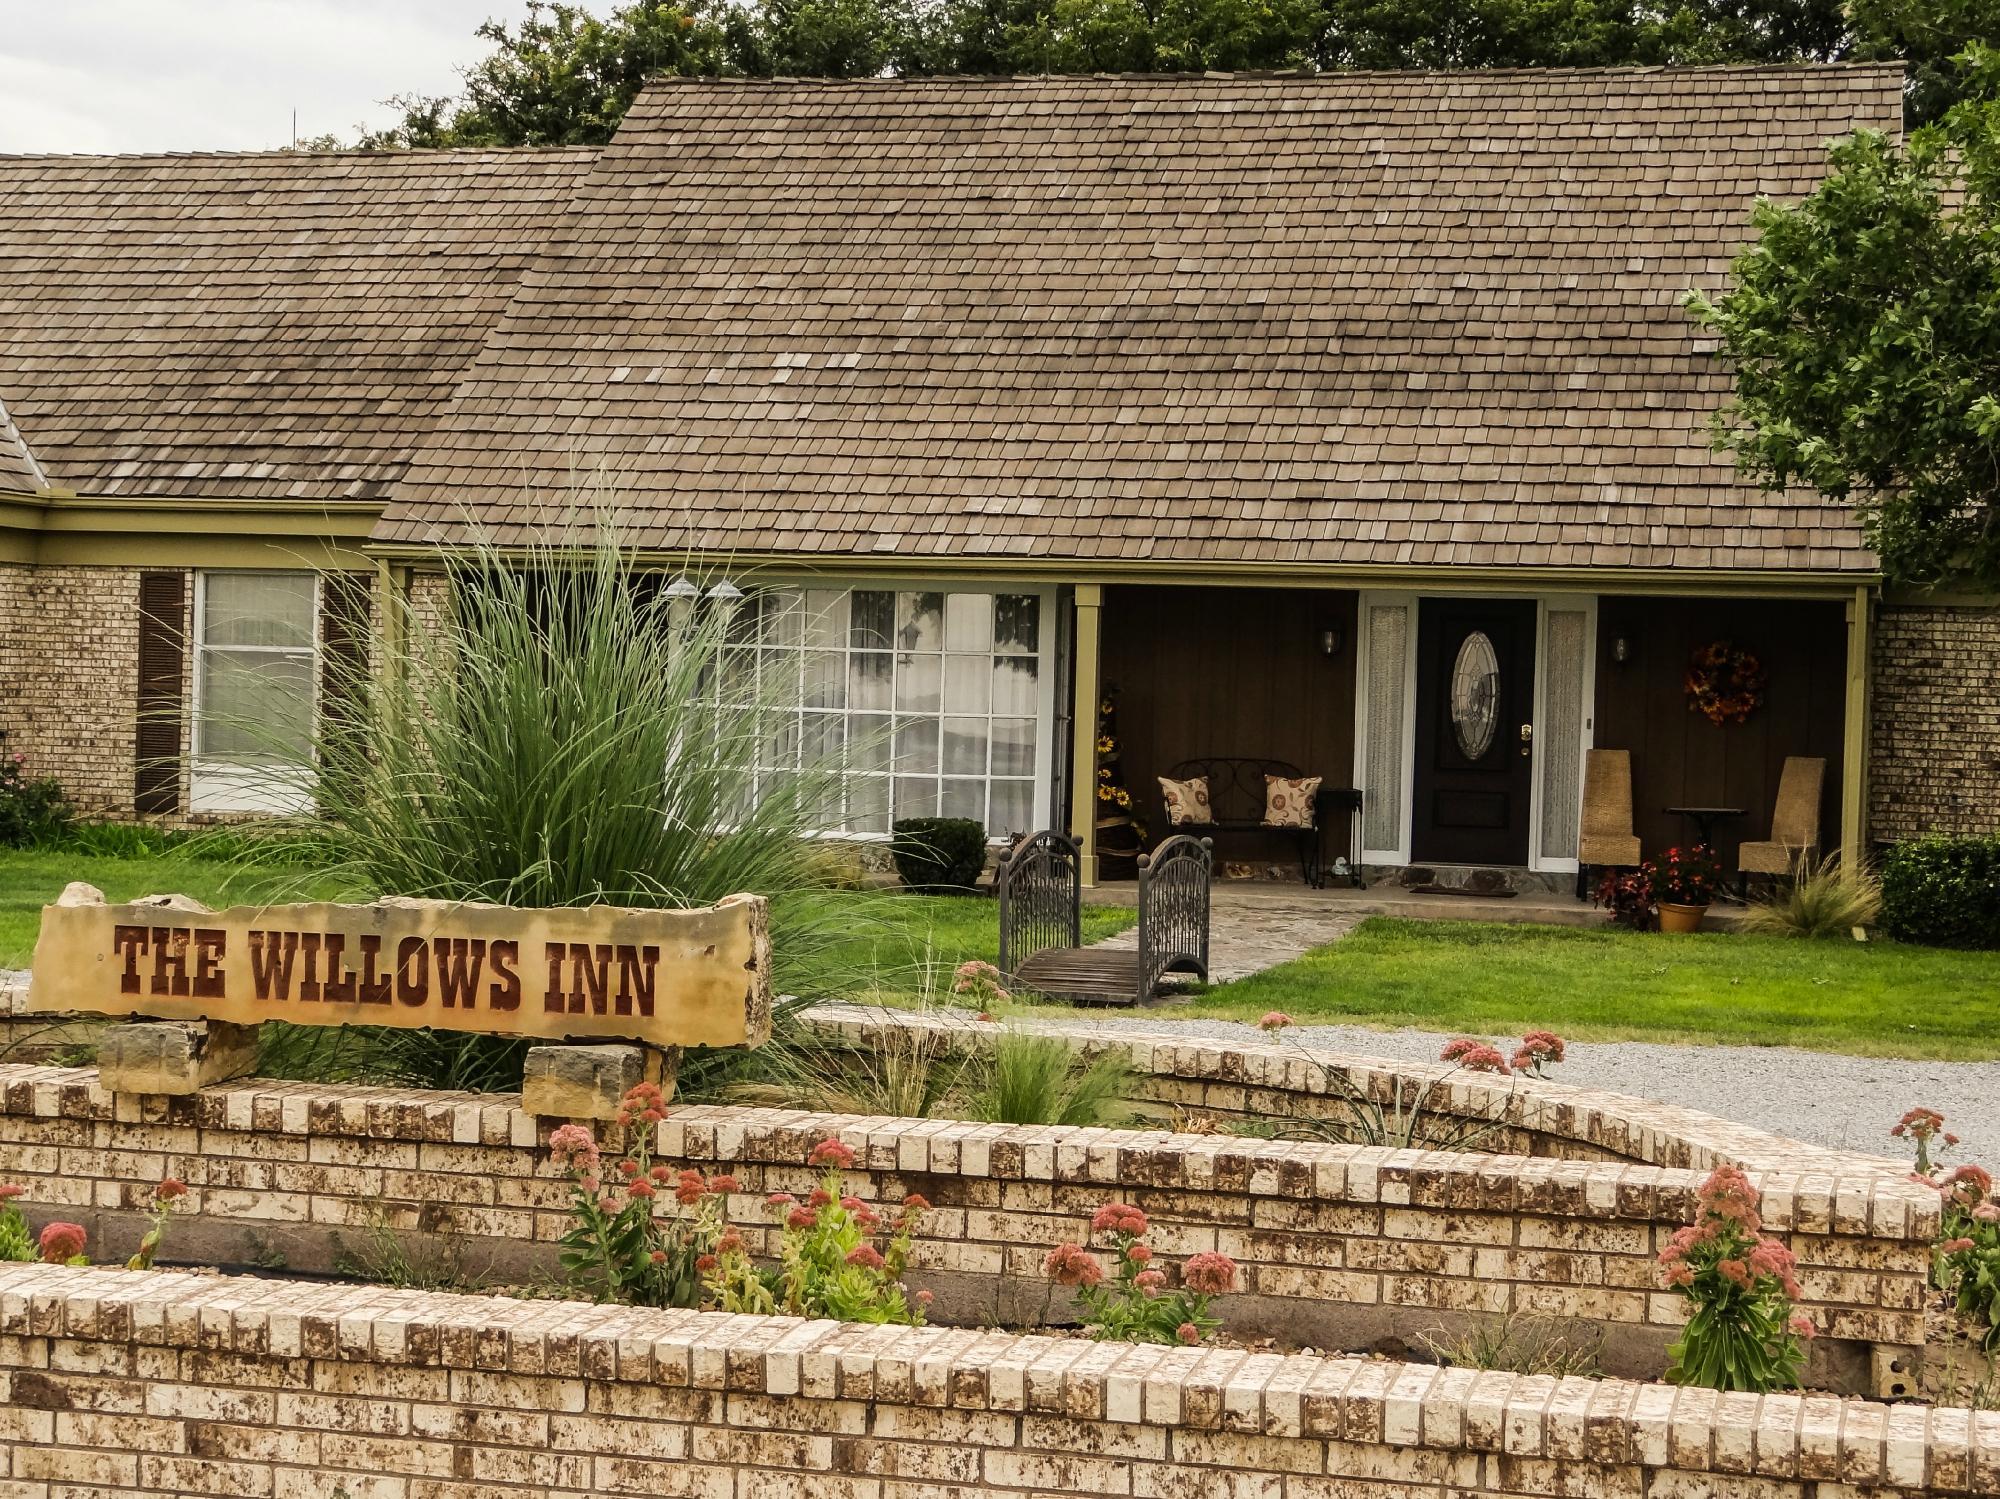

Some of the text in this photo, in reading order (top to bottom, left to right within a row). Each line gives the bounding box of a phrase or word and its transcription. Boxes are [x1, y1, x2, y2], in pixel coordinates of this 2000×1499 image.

[114, 925, 660, 1017] THE WILLOWS INN
